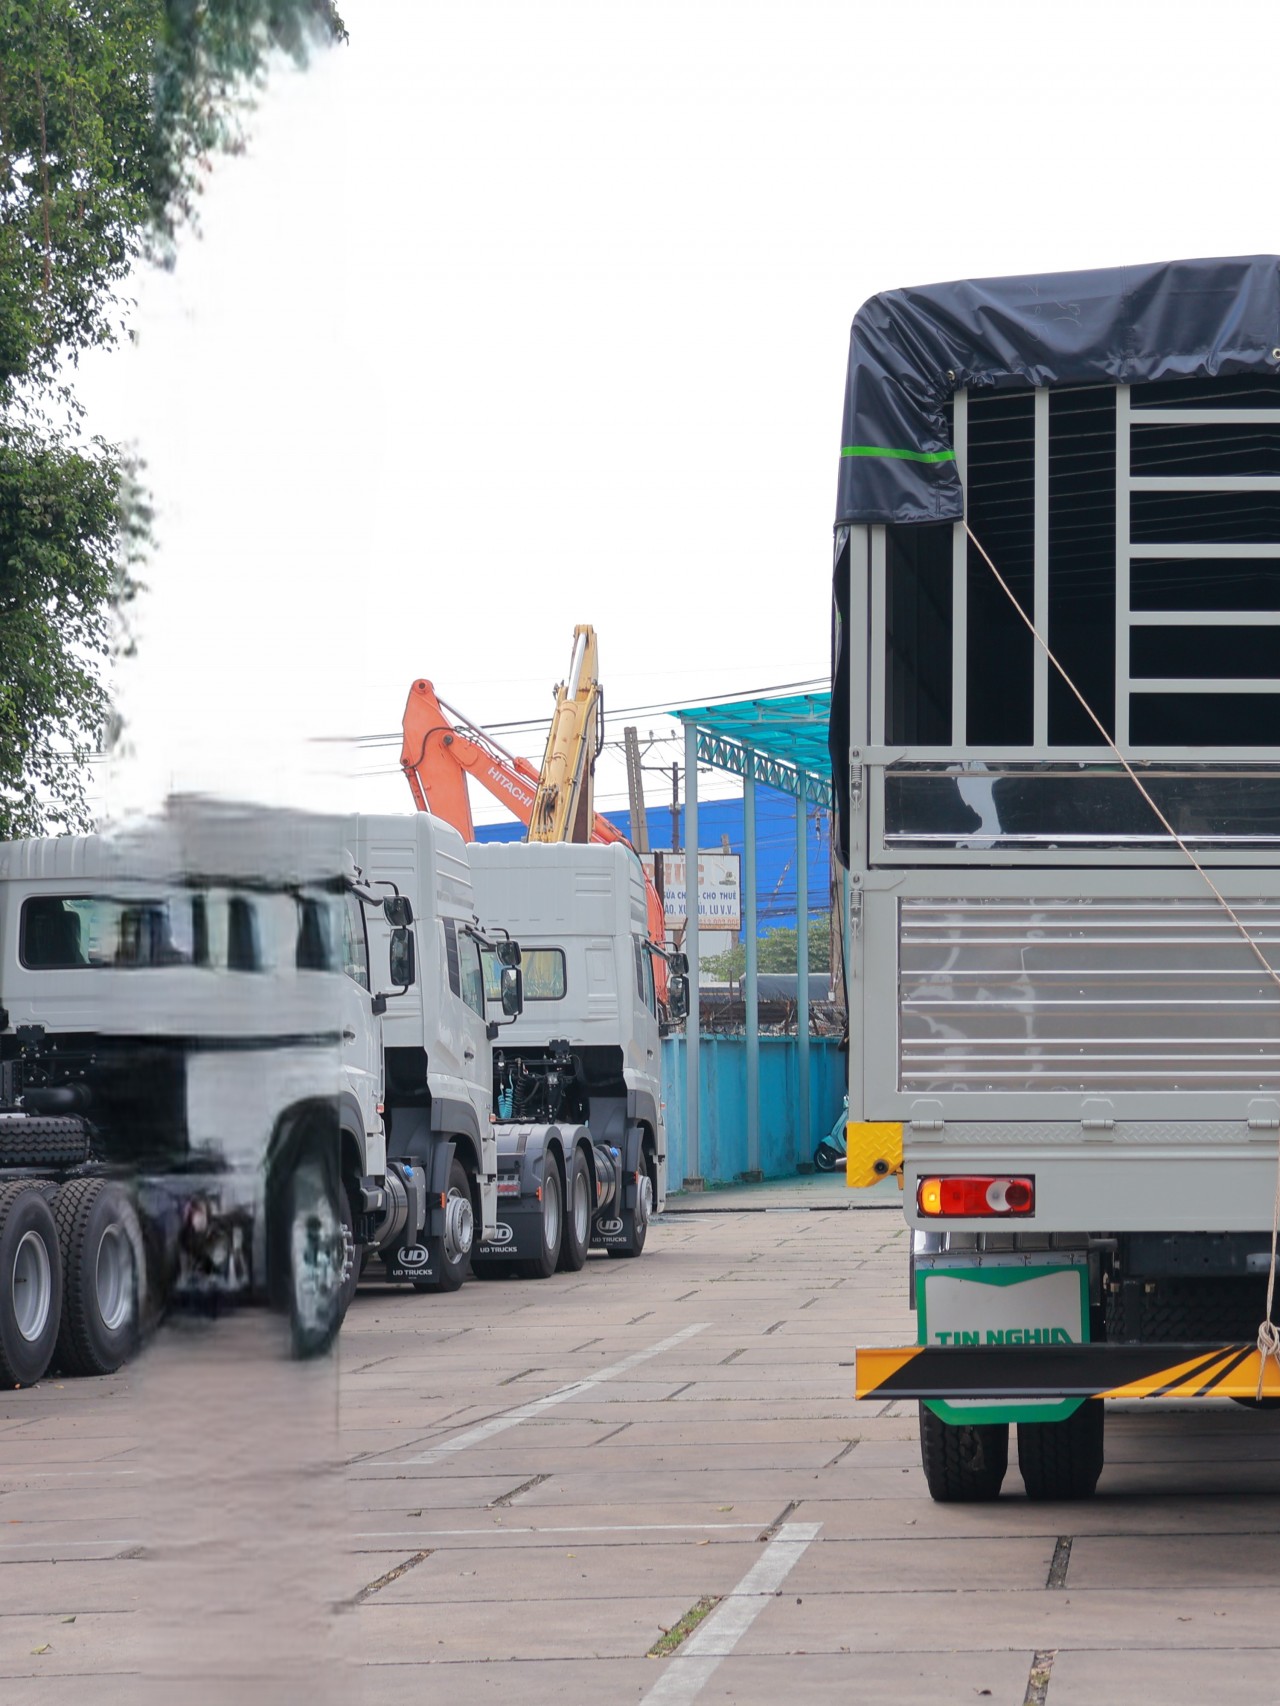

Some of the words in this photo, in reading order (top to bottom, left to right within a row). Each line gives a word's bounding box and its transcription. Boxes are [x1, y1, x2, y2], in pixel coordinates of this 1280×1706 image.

[487, 766, 533, 807] HITACHI
[702, 892, 717, 900] CHO
[719, 889, 737, 900] THUÊ
[400, 1250, 427, 1261] UD
